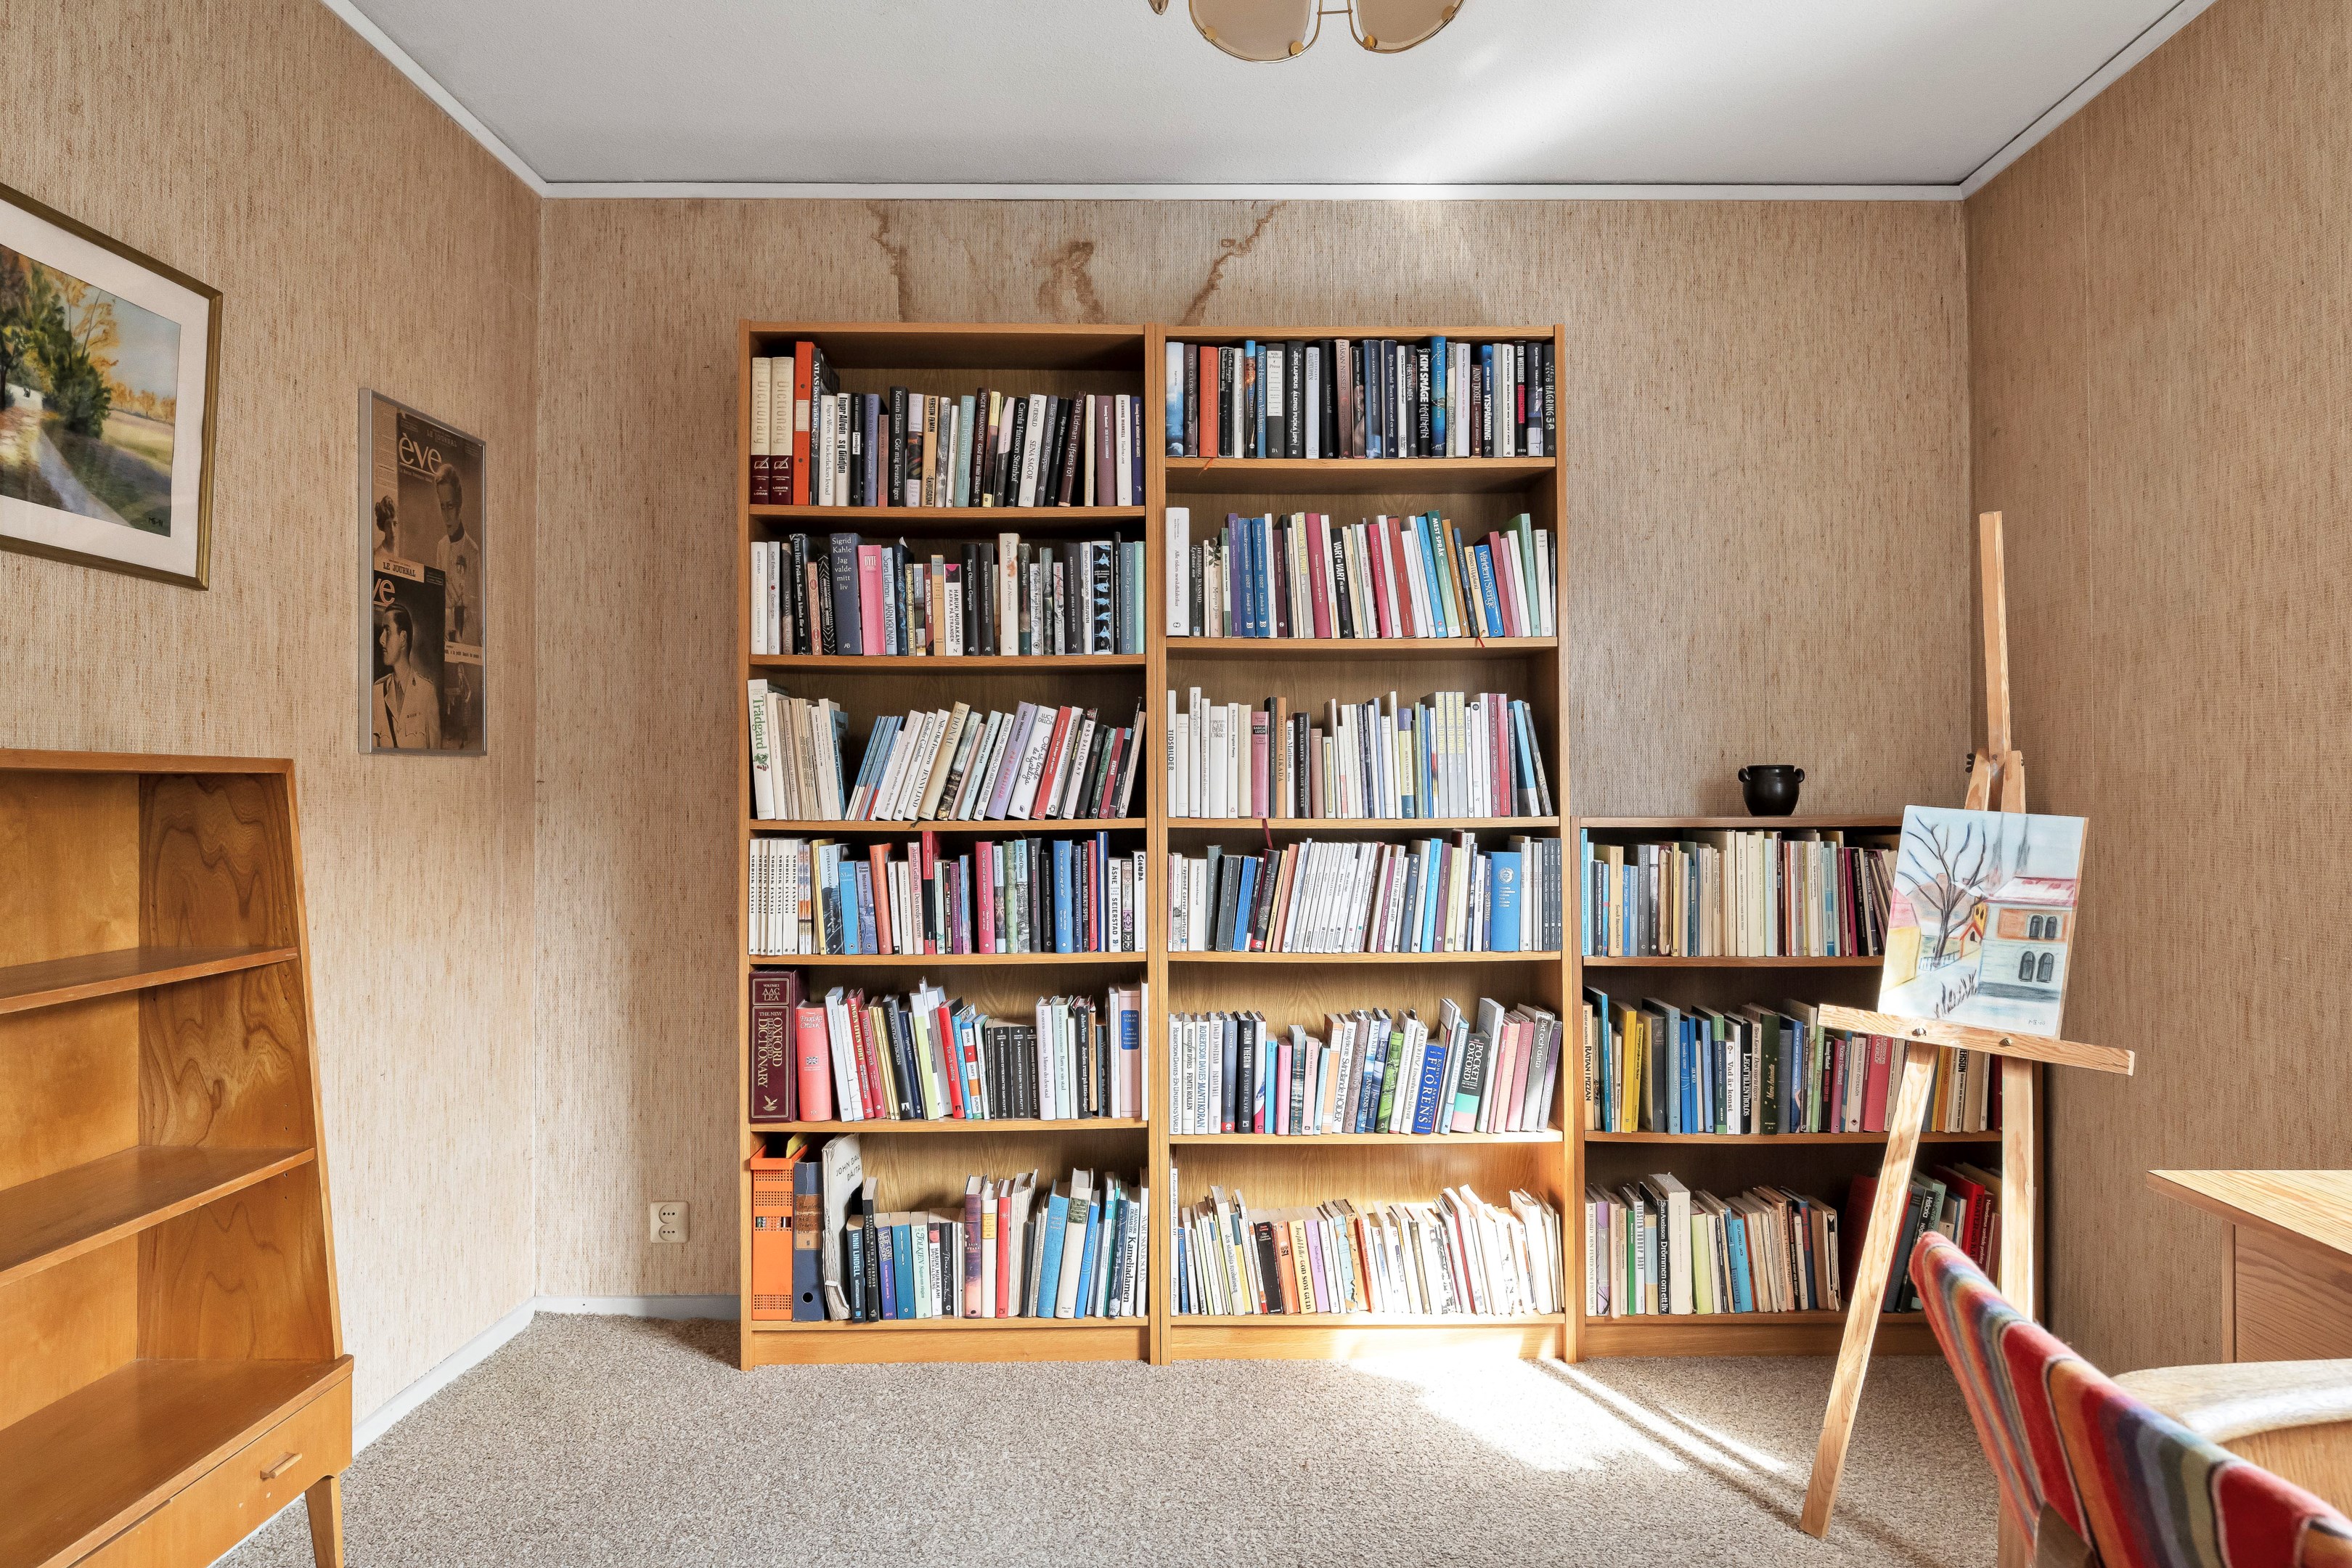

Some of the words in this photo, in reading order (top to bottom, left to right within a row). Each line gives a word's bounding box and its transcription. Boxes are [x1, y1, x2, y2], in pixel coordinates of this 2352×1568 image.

[1420, 354, 1429, 372] KIM
[1420, 372, 1430, 402] SMÅGE
[1016, 402, 1026, 425] Carola
[1419, 404, 1429, 438] KAINAN
[1014, 426, 1024, 453] Hansson
[1045, 417, 1055, 443] Johansson
[1071, 415, 1081, 440] Lidman
[1029, 440, 1037, 457] SENA
[1041, 446, 1051, 472] Mosippan
[1067, 443, 1077, 465] Lifsens
[1010, 454, 1021, 483] Steinhof
[1026, 457, 1036, 479] SAGOR
[1066, 467, 1074, 477] rot
[1435, 536, 1445, 557] SPRÅK
[393, 565, 415, 577] JOURNAL
[883, 555, 892, 573] Sara
[1478, 551, 1490, 579] Världen
[884, 574, 894, 598] Lidman
[1482, 583, 1495, 610] Sverige
[949, 605, 955, 615] PÅ
[884, 602, 894, 646] JÄRNKRONAN
[750, 695, 768, 750] Trädgård
[944, 716, 961, 748] DONAU
[1021, 756, 1037, 785] lyckliga
[1075, 740, 1089, 776] DALLOWAY
[1483, 891, 1492, 921] Språkbitar
[851, 1004, 859, 1025] INGEN
[772, 1017, 783, 1067] OXFORD
[853, 1026, 862, 1043] LITEN
[888, 1008, 902, 1065] SPRÅKRIKTIGHETSBOKEN
[1244, 1027, 1253, 1045] JOHAN
[757, 1018, 768, 1088] DICTIONARY
[856, 1044, 865, 1061] LORT
[1243, 1047, 1251, 1069] THEORIN
[1463, 1042, 1476, 1081] OXFORD
[1471, 1044, 1484, 1082] POCKET
[1418, 1056, 1438, 1123] FLORENS
[1728, 1078, 1734, 1087] är
[1197, 1082, 1206, 1127] MANTIKORAN
[1922, 1196, 1934, 1218] Historia
[1983, 1199, 1991, 1228] Nostradamus
[878, 1233, 887, 1262] PERSSON
[1978, 1246, 1987, 1265] profetior
[1123, 1236, 1138, 1303] Kameliadamen
[1661, 1279, 1667, 1292] om
[1303, 1291, 1312, 1310] GULD
